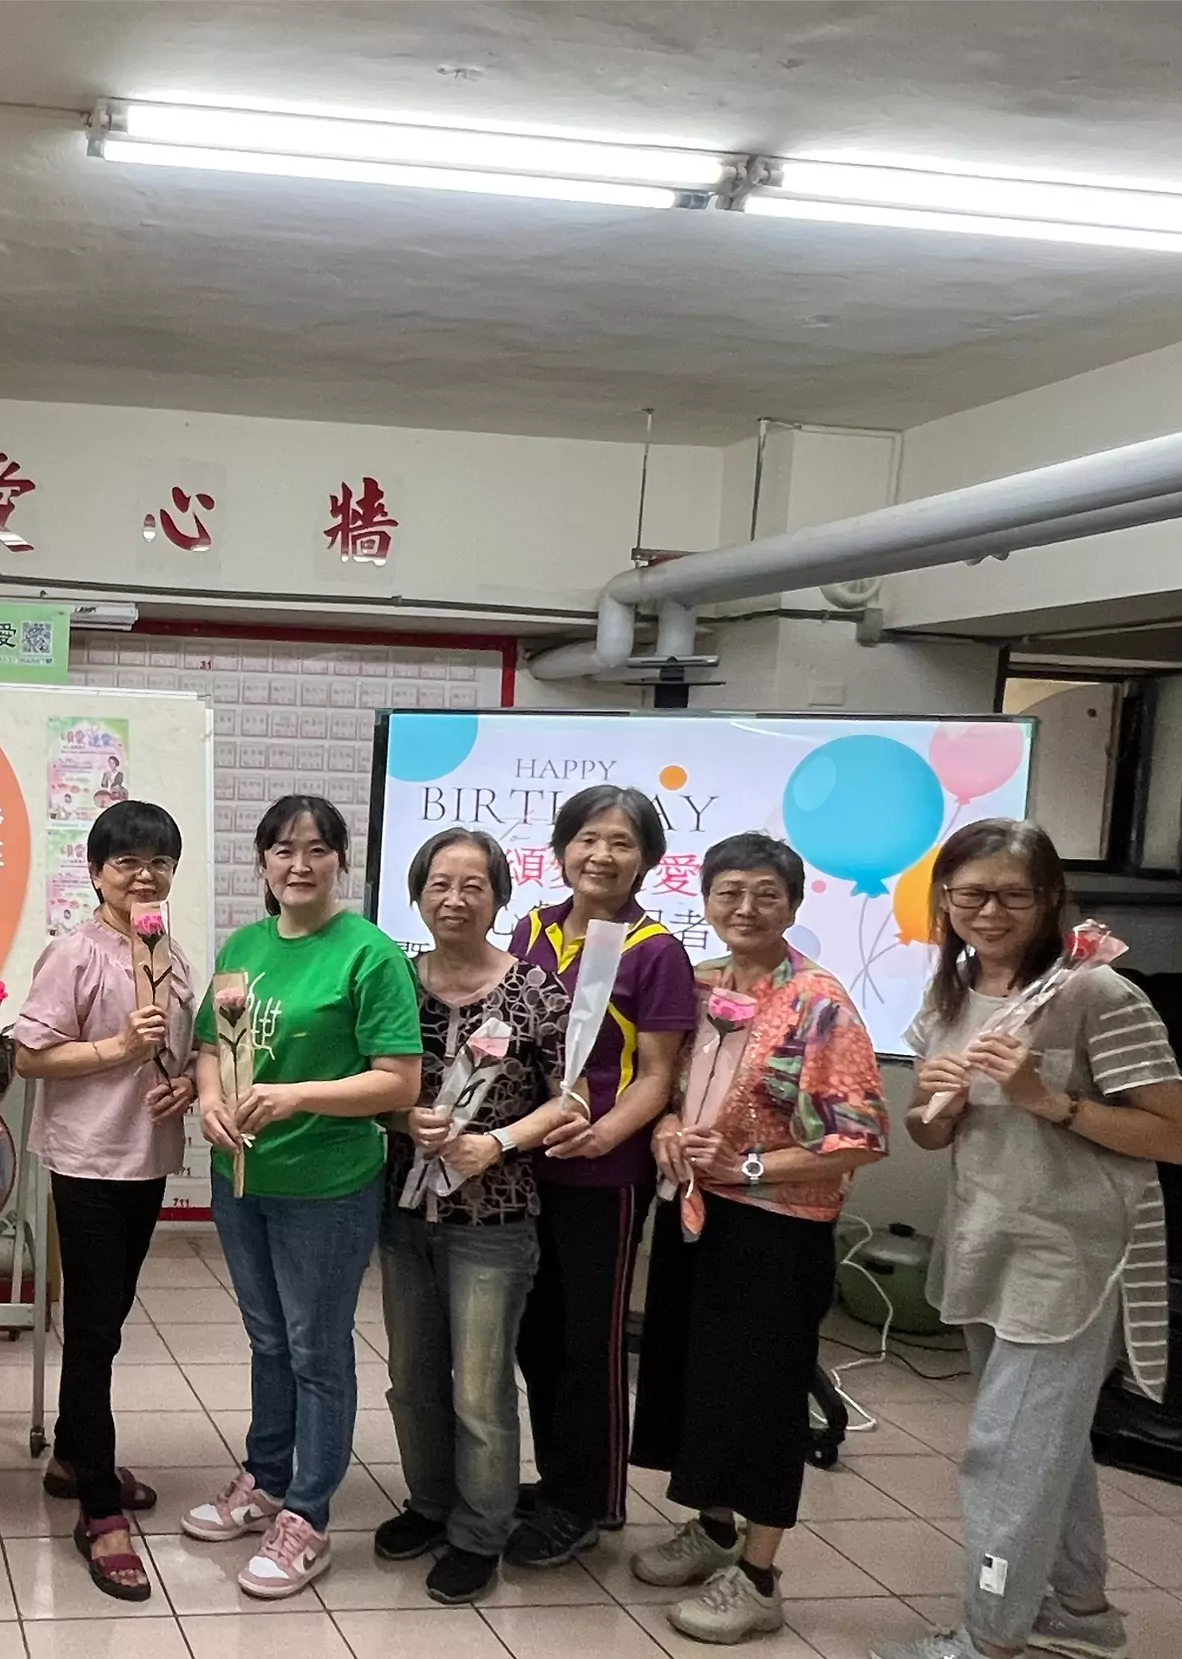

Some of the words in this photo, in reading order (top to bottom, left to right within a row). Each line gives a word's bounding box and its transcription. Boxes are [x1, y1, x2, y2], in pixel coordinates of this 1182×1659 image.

[200, 660, 212, 670] 31
[514, 758, 617, 780] HAPPY
[421, 786, 720, 832] BIRTAY
